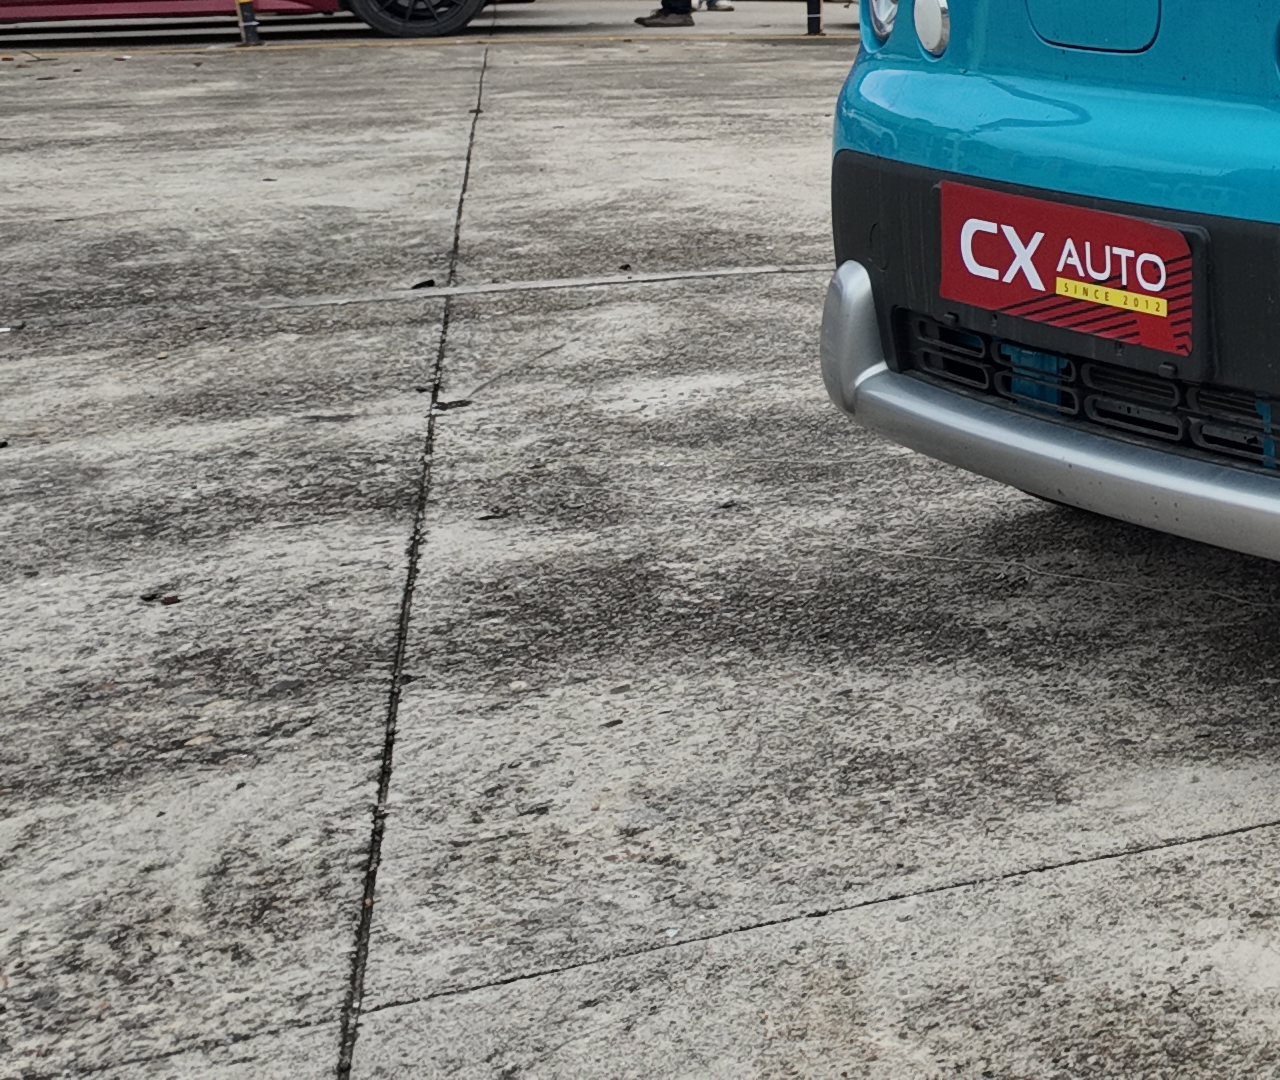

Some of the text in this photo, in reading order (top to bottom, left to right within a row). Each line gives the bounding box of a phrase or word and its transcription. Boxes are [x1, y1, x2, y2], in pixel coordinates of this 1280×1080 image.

[960, 218, 1166, 292] CX AUTO
[1064, 282, 1161, 313] SINCE 2012
